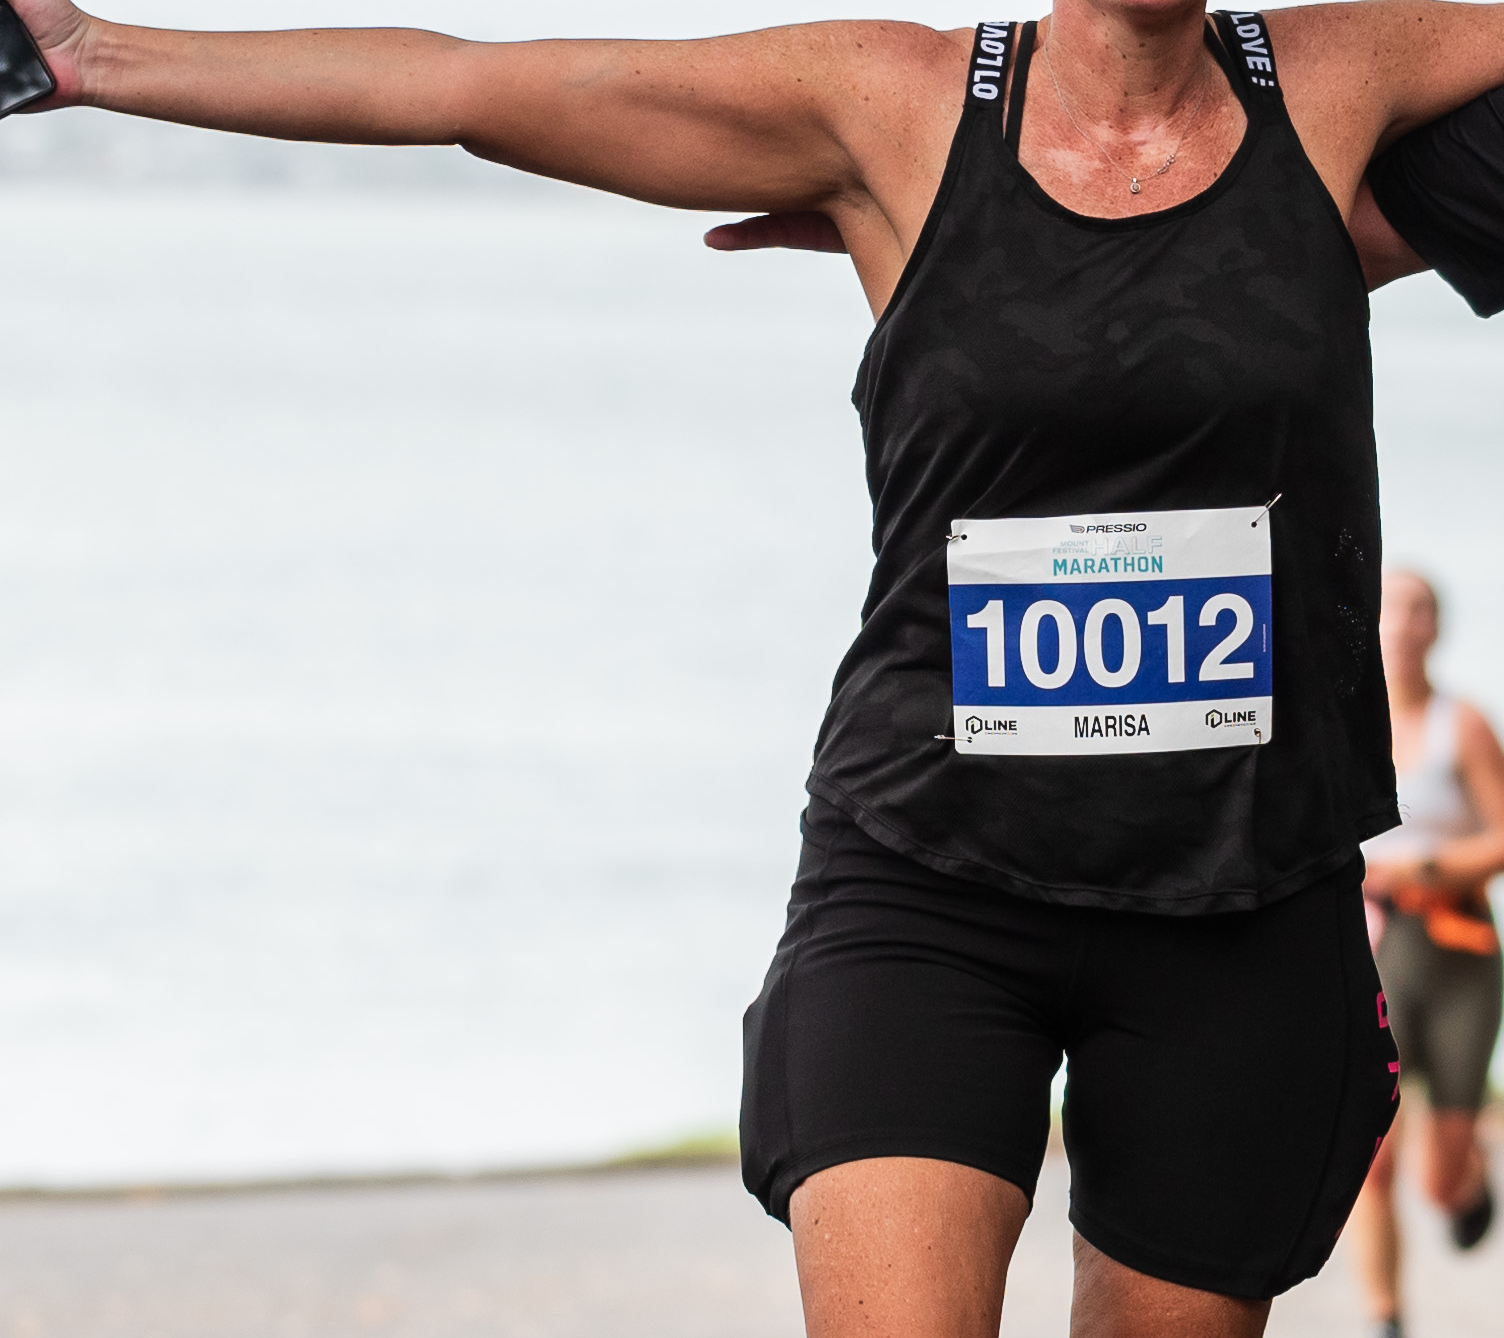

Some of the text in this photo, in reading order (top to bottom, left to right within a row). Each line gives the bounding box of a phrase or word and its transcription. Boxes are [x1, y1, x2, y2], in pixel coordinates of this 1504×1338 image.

[1086, 523, 1147, 534] PRESSIO
[1091, 535, 1163, 556] HALF
[1053, 556, 1163, 576] MARATHON
[966, 593, 1255, 690] 10012
[1074, 714, 1150, 738] MARISA
